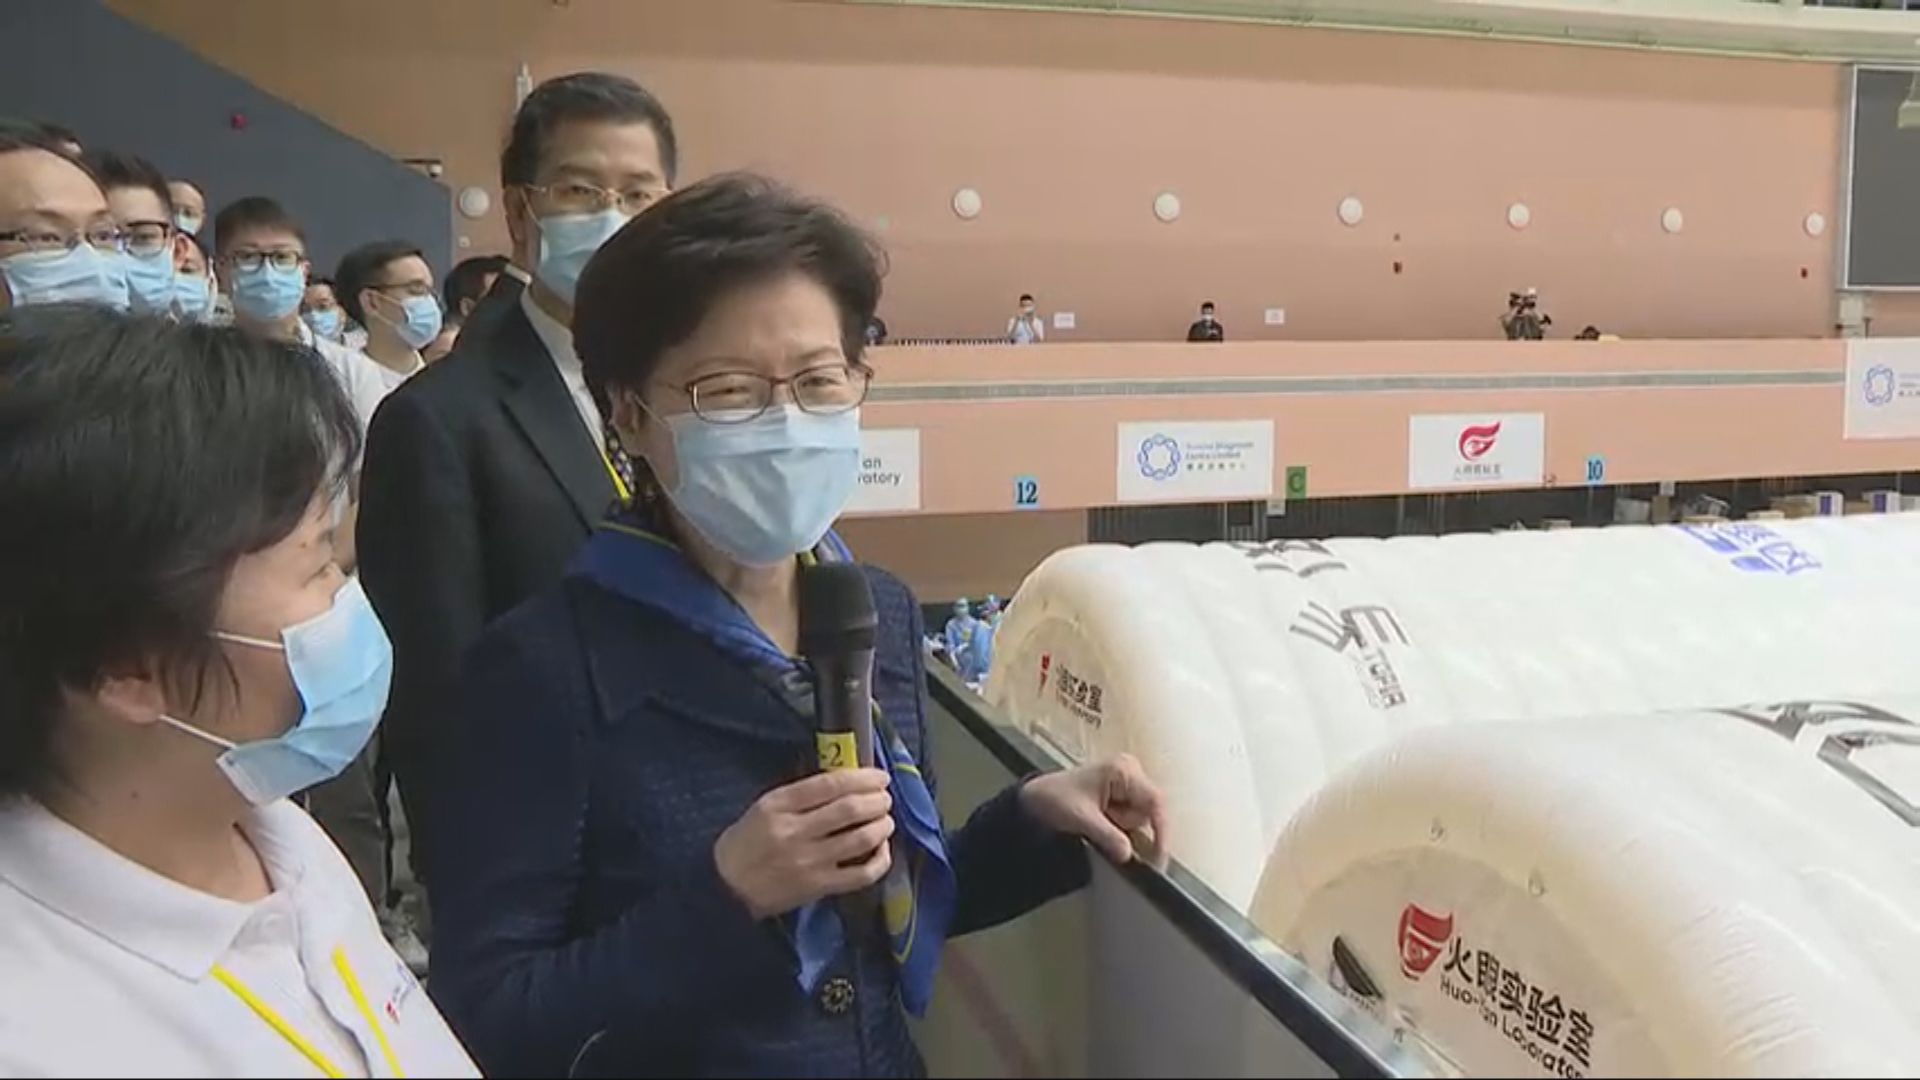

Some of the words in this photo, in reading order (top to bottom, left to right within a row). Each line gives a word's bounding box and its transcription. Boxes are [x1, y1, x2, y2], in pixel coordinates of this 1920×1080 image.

[1587, 459, 1604, 481] 10
[1016, 480, 1038, 505] 12
[1443, 935, 1595, 1068] 火眼实验室
